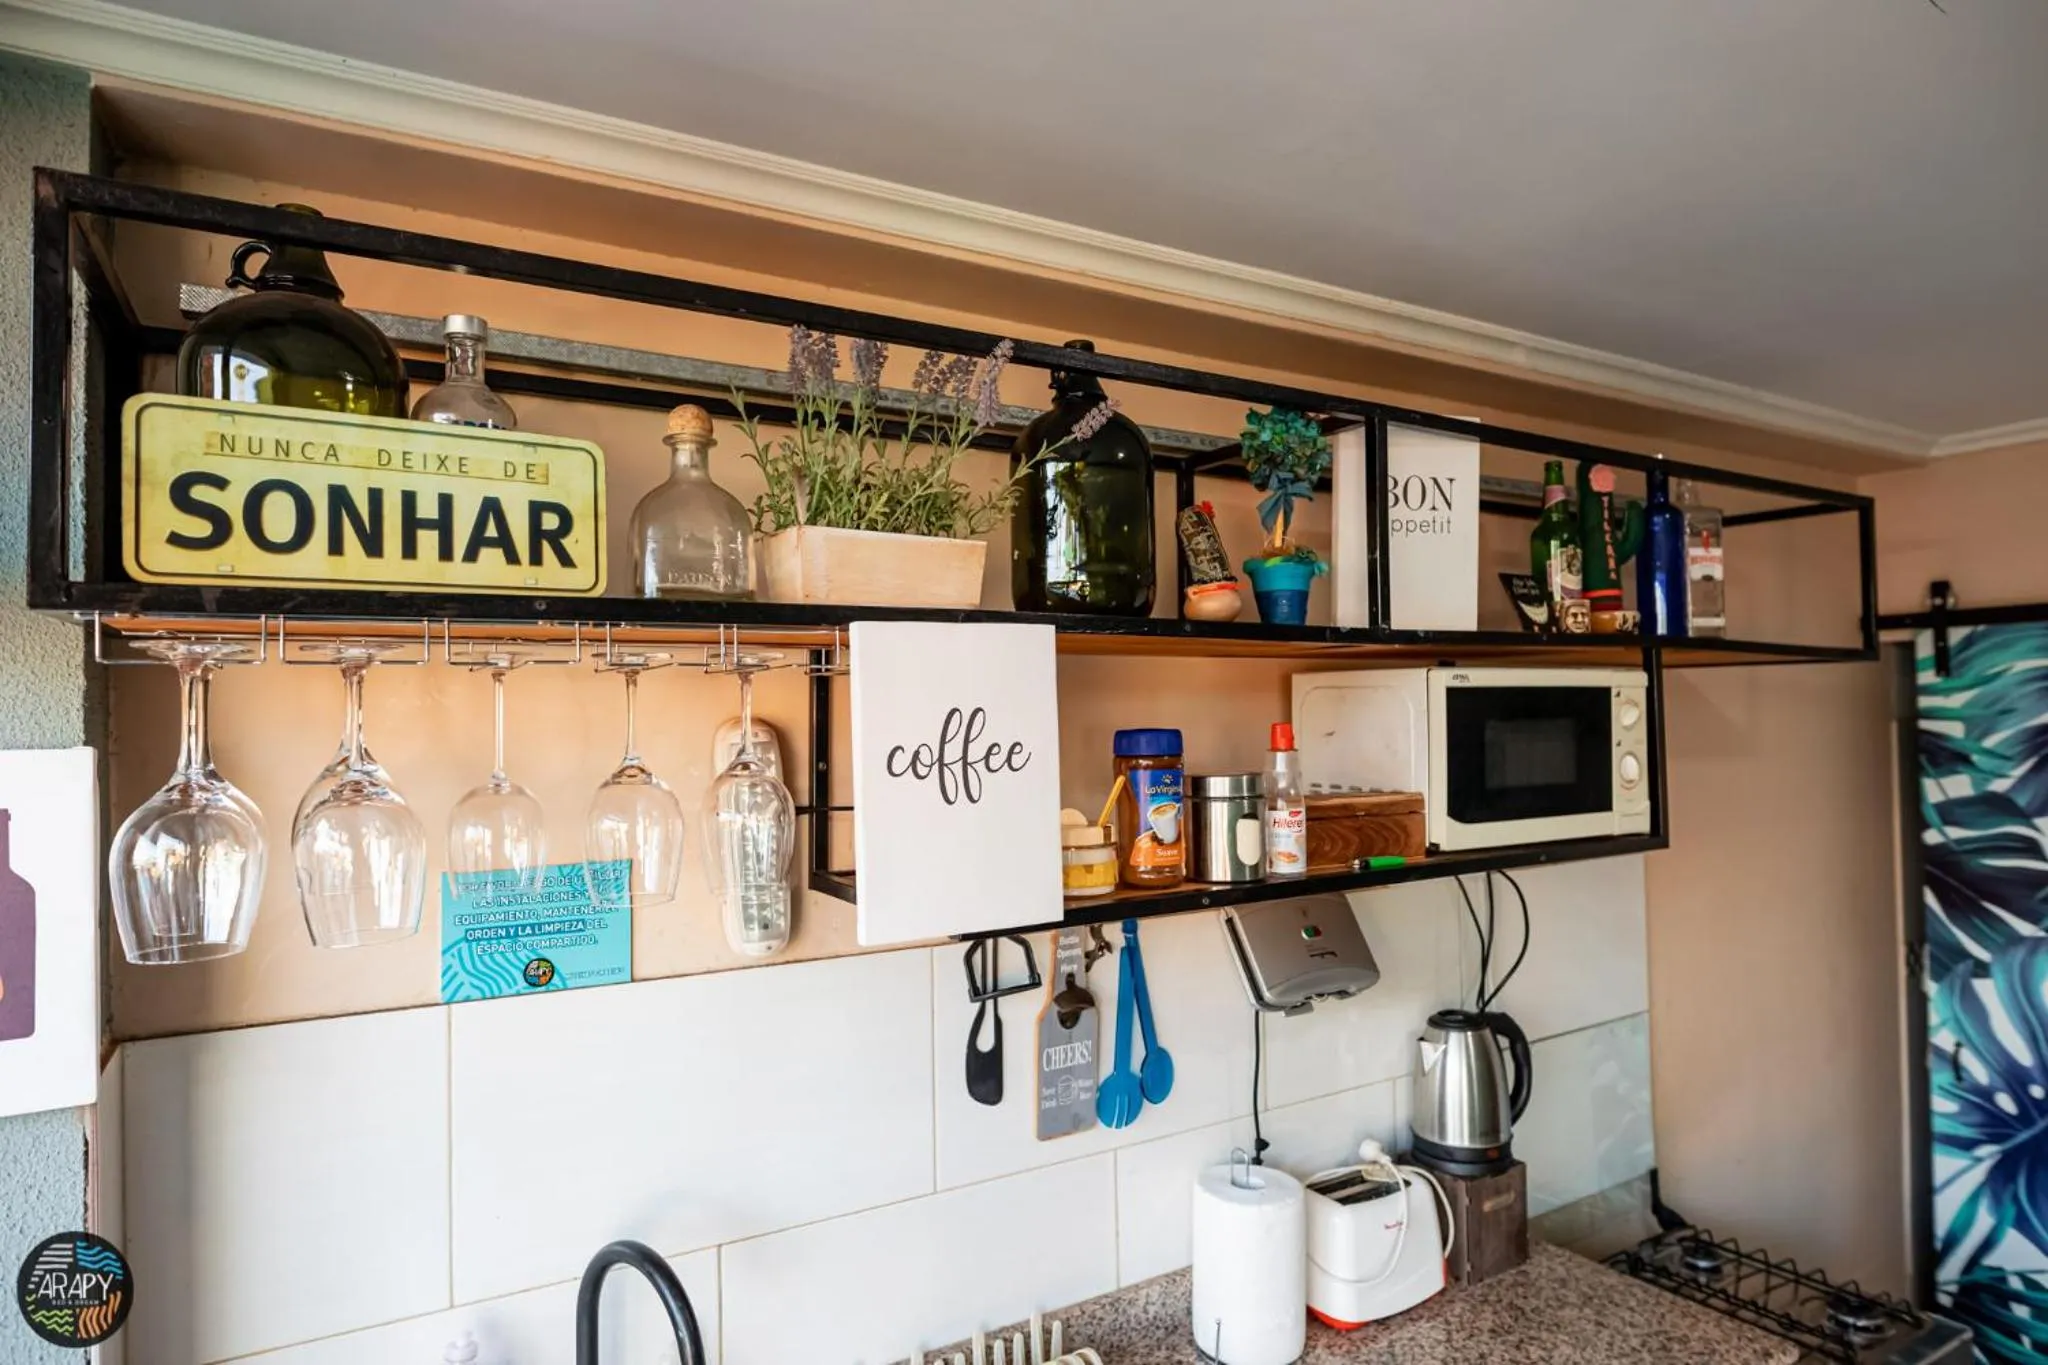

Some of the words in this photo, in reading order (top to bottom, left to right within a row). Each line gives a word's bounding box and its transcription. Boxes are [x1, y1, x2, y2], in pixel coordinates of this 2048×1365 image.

[219, 433, 341, 463] NUNCA
[377, 448, 471, 476] DEIXE
[503, 461, 538, 481] DE
[164, 470, 578, 570] SONHAR
[1389, 515, 1452, 538] ppetit
[886, 706, 1033, 806] coffee
[466, 928, 507, 940] ORDEN
[508, 926, 515, 936] Y
[518, 925, 532, 936] LA
[534, 921, 585, 934] LIMPIEZA
[586, 919, 608, 930] DEL
[477, 941, 525, 956] ESPACIO
[1043, 1040, 1092, 1072] CHEERS!
